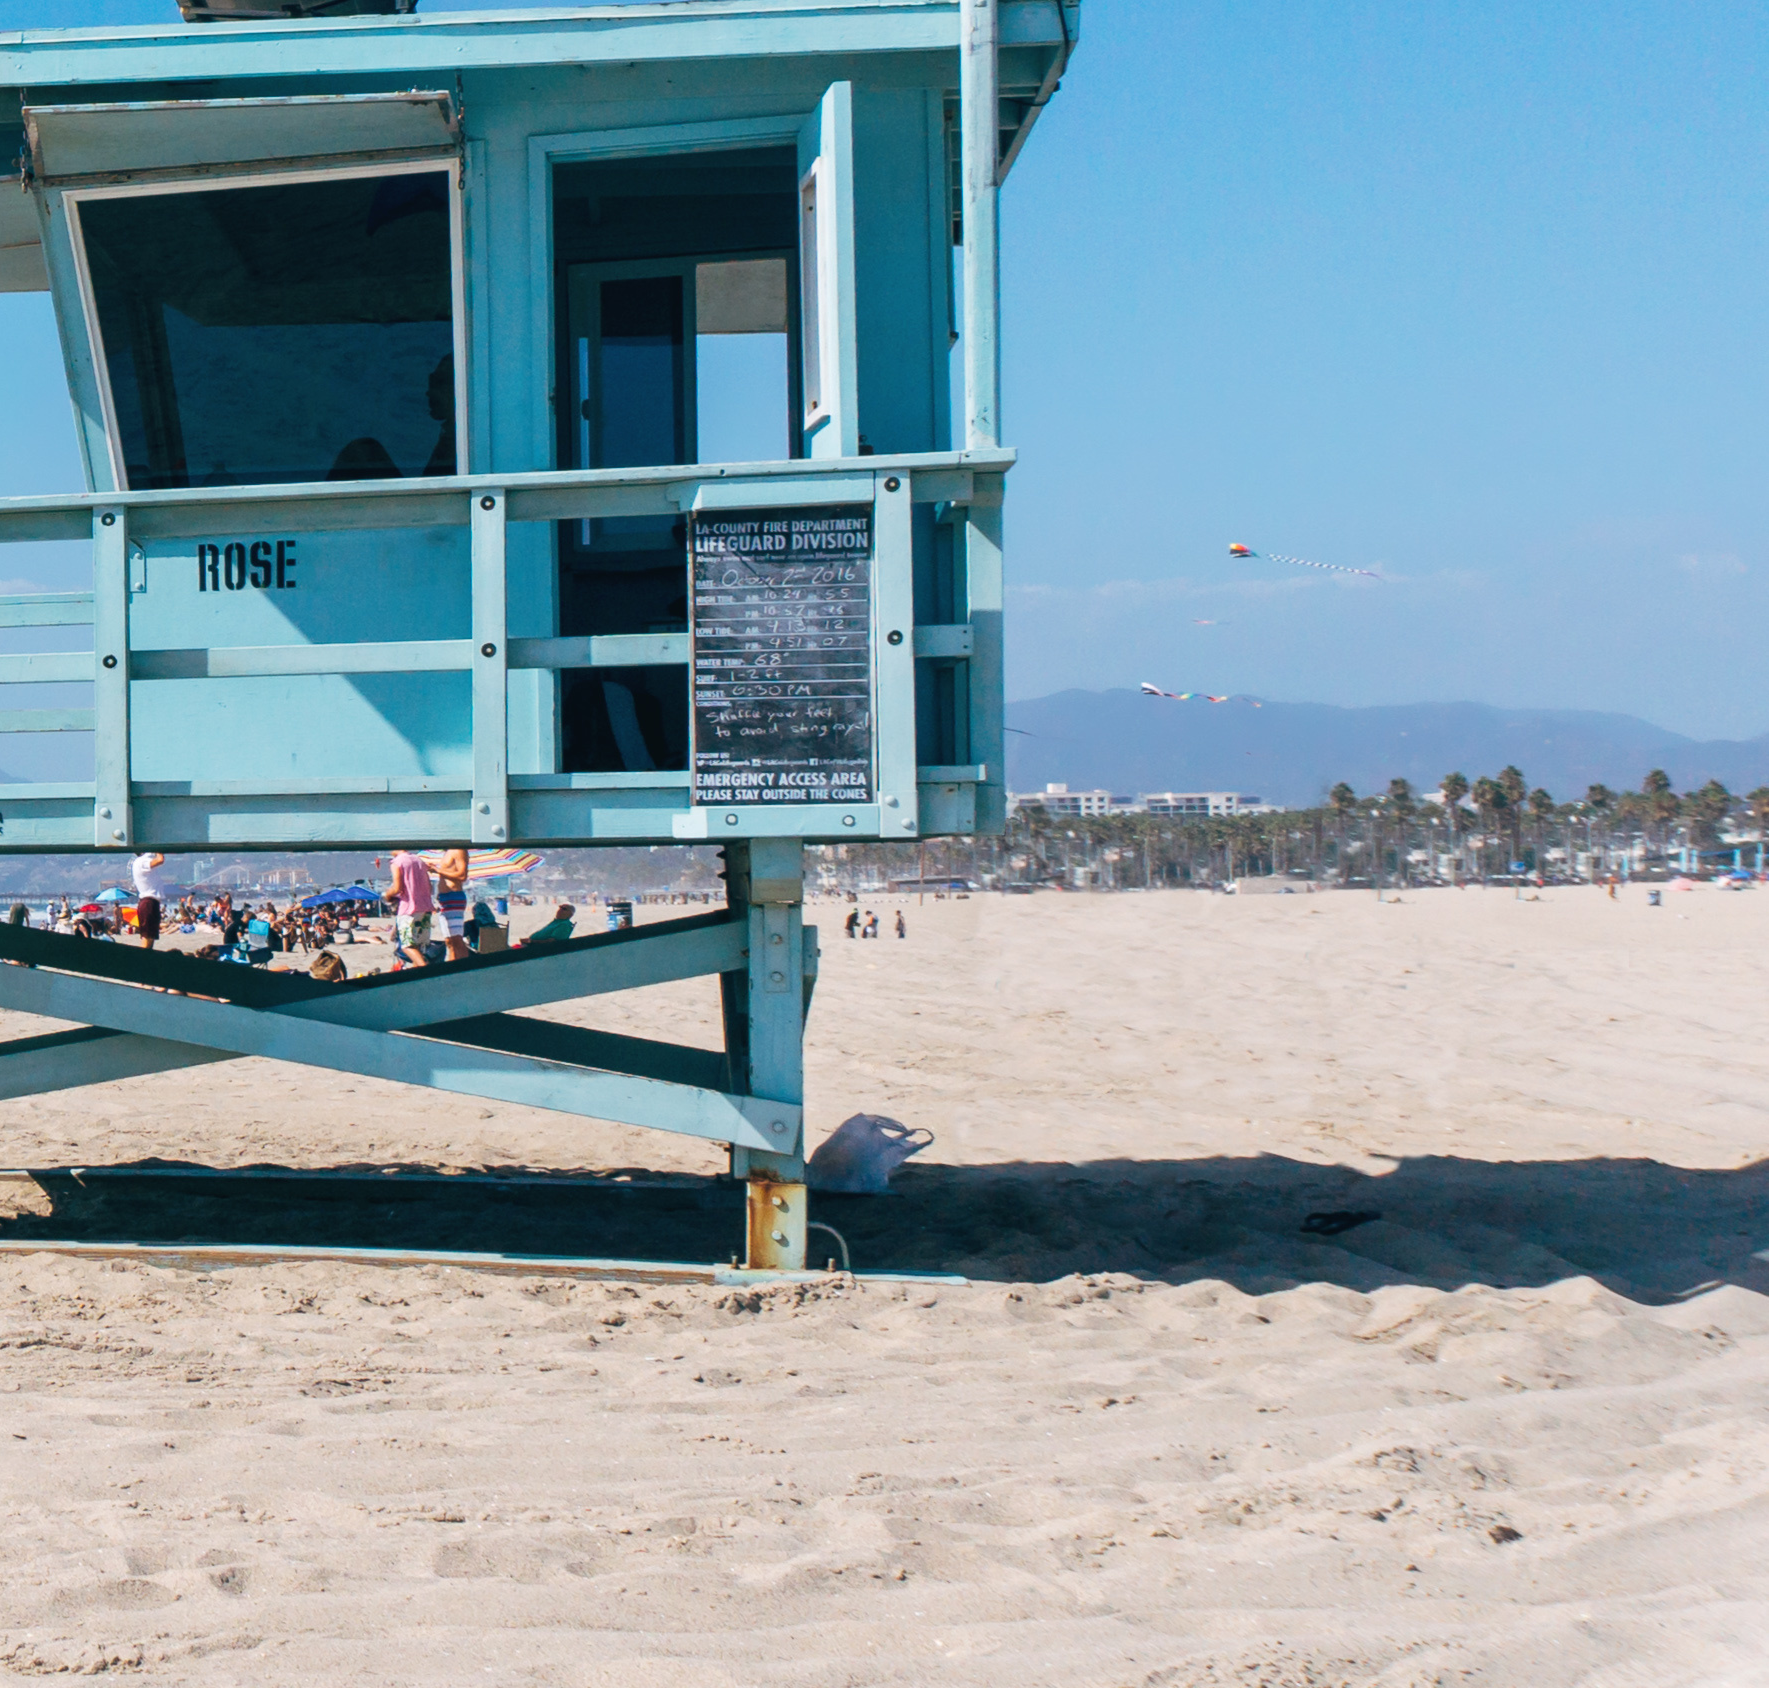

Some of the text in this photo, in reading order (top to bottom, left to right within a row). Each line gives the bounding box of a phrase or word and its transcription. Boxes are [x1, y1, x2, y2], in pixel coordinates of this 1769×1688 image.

[763, 520, 788, 533] FIRE
[792, 518, 868, 532] DEPARTMENT
[695, 532, 869, 553] LIFEGUARD DIVISION
[198, 540, 296, 592] ROSE
[811, 567, 856, 584] 2016
[732, 684, 811, 696] 6:30 PM
[715, 725, 731, 738] to
[739, 722, 779, 736] avoid
[695, 772, 867, 787] EMERGENCY ACCESS AREA
[695, 788, 868, 801] PLEASE STAY OUTSIDE THE CONES
